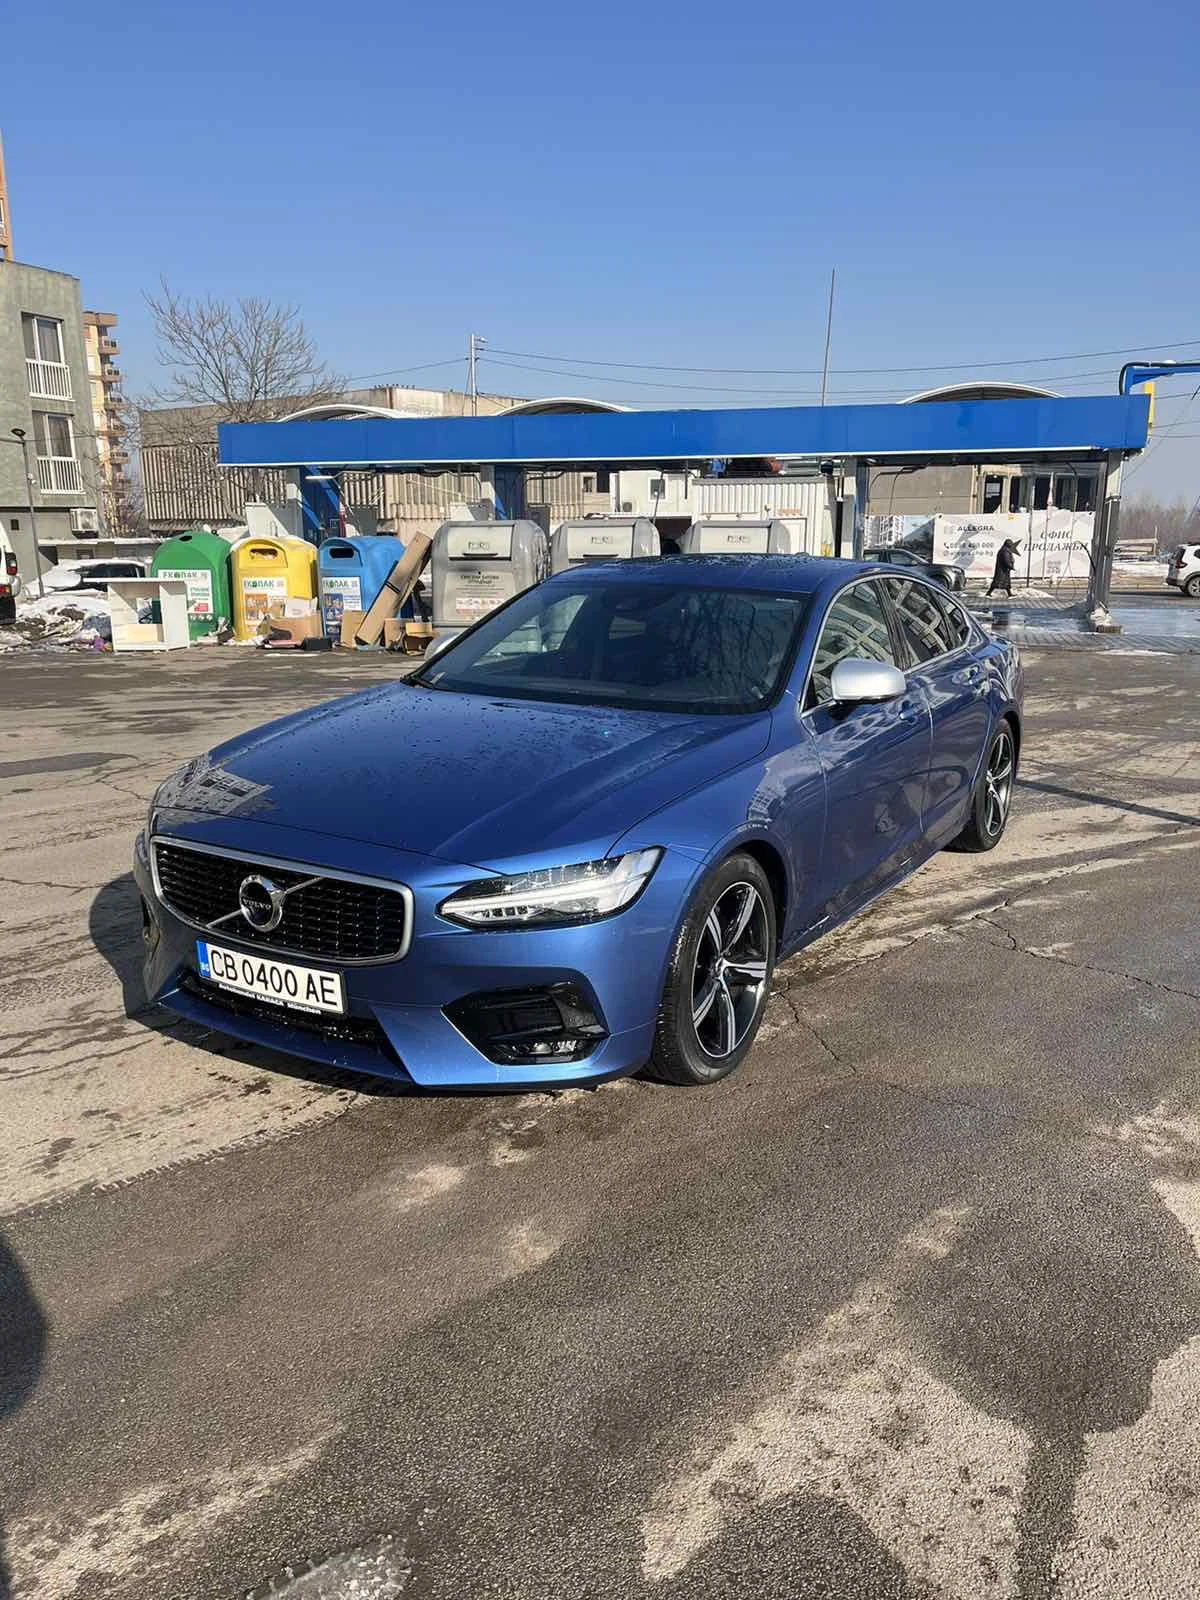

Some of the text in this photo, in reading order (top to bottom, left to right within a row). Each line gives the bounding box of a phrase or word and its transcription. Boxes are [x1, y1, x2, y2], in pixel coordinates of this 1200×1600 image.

[1040, 530, 1073, 539] ОФИС
[243, 899, 272, 910] VOLVO
[210, 949, 239, 981] CB
[241, 958, 298, 997] 0400
[306, 973, 338, 1006] AE
